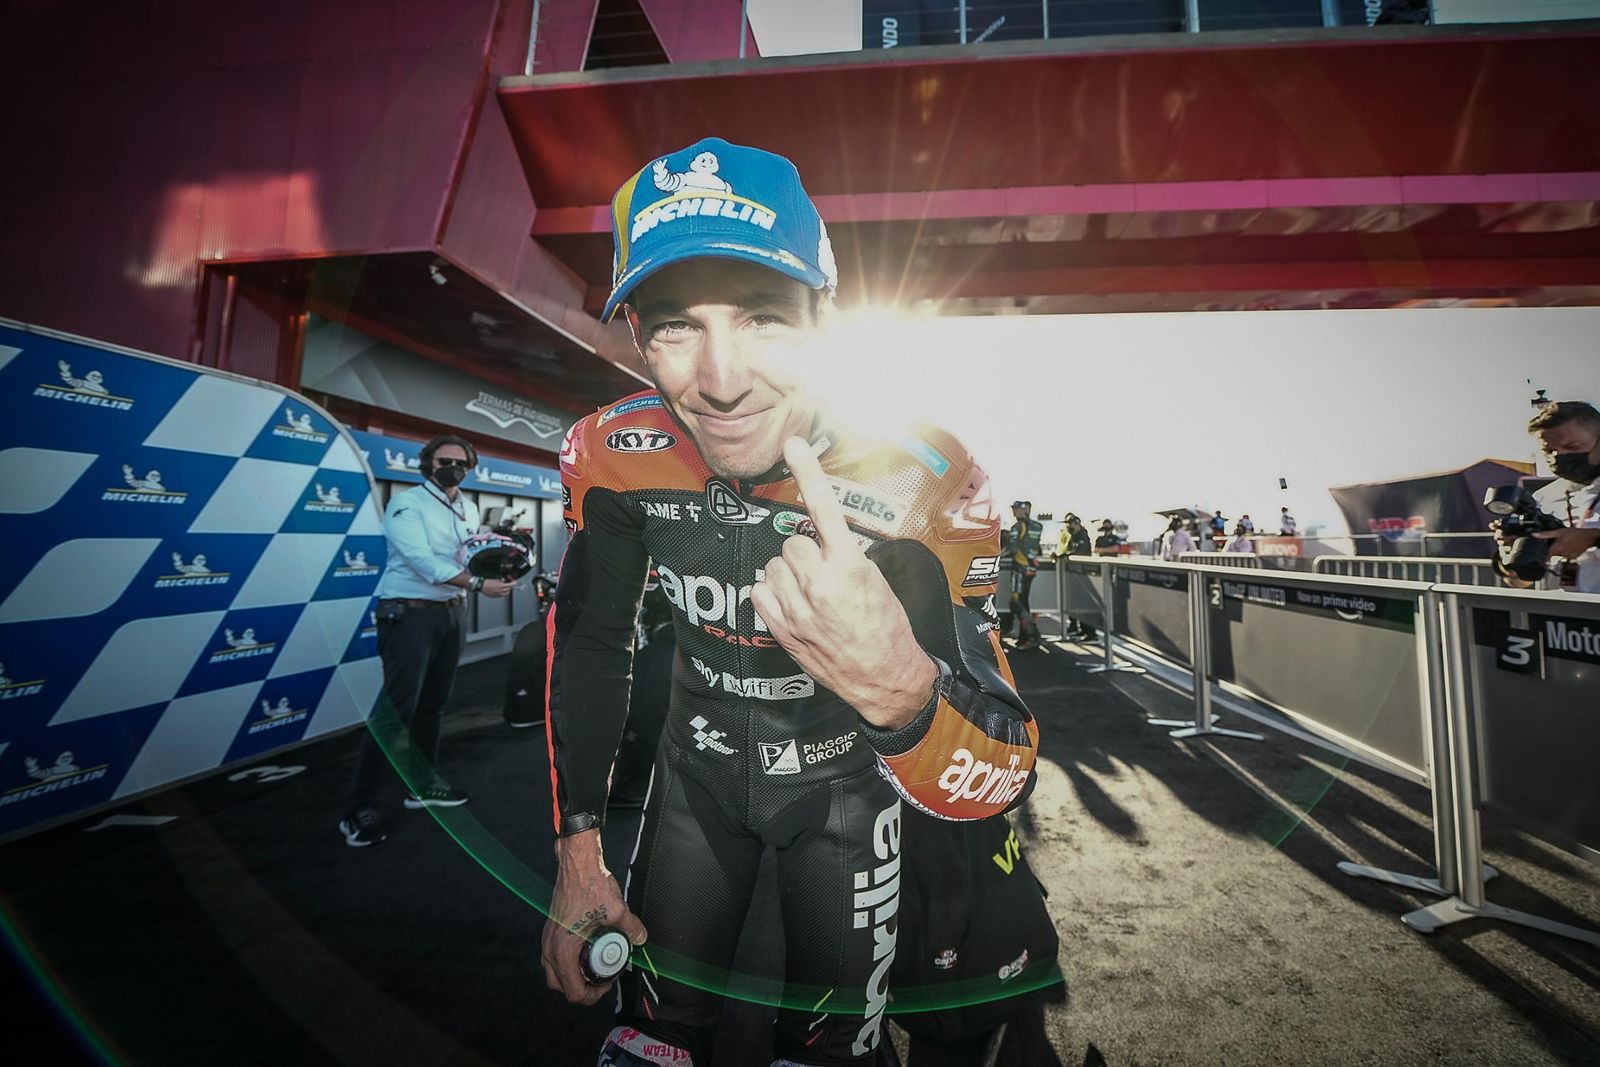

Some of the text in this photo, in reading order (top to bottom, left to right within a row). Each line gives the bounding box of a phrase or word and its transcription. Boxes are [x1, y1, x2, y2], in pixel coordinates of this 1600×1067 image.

[631, 197, 776, 243] MICHELIN
[33, 387, 135, 411] MICHELIN
[478, 392, 513, 413] TERMAS
[272, 428, 328, 444] MICHELIN
[613, 432, 669, 449] KYT
[490, 471, 532, 486] MICHELIN
[102, 490, 188, 505] MICHELIN
[304, 503, 355, 514] MICHELIN
[333, 567, 379, 578] MICHELIN
[968, 555, 1000, 575] S
[154, 576, 231, 589] MICHELIN
[1210, 589, 1221, 606] 2
[1322, 595, 1348, 609] prime
[1348, 597, 1376, 612] video
[209, 646, 275, 663] MICHELIN
[1501, 635, 1535, 666] 3
[248, 711, 308, 735] MICHELIN
[803, 732, 858, 753] PIAGGIO
[805, 742, 854, 764] GROUP
[939, 748, 1029, 804] aprilia
[0, 767, 108, 806] MICHELIN
[585, 904, 608, 920] GAS
[852, 799, 901, 1057] aprilia
[643, 1043, 672, 1057] TEAM
